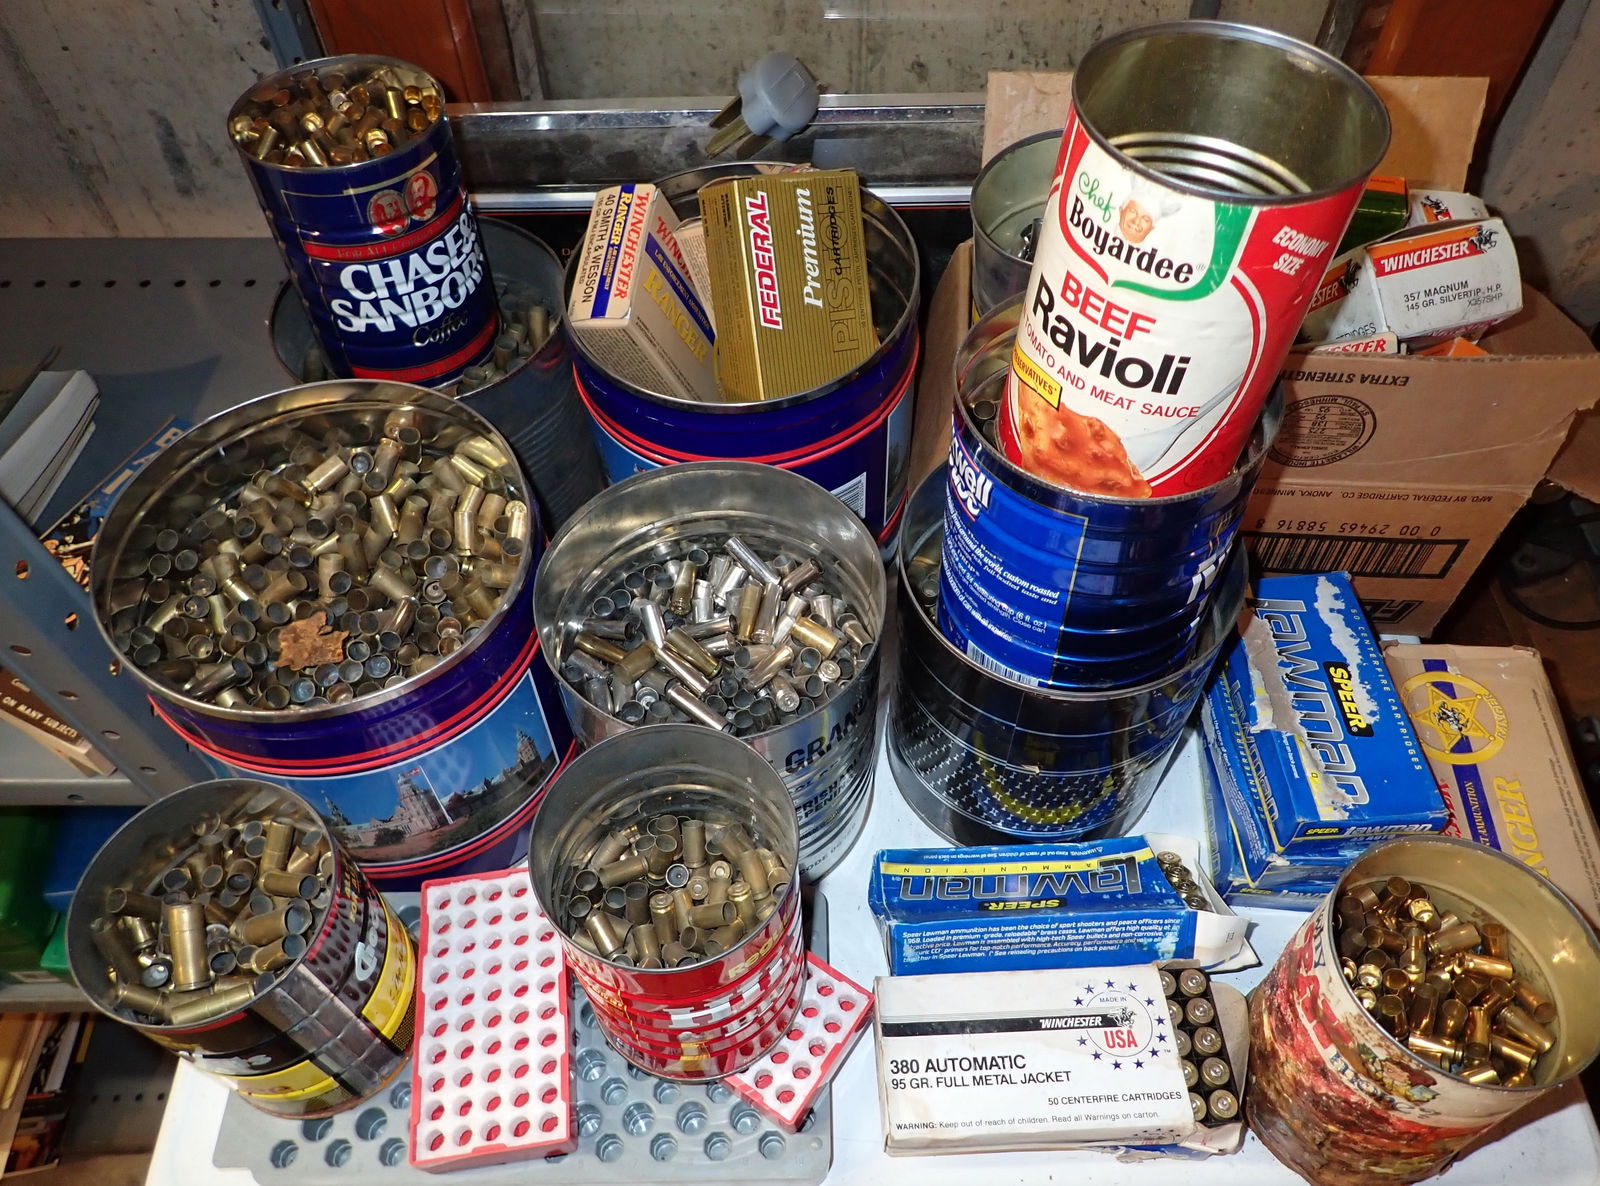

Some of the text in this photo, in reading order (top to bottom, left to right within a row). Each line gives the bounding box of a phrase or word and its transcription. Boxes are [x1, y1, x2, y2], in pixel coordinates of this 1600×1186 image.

[1078, 172, 1117, 224] Chef
[610, 191, 633, 247] RANGER
[825, 185, 843, 276] CARTRIDGES
[582, 193, 617, 304] 40 SMITH & WESSON
[613, 191, 651, 300] WINCHESTER
[796, 187, 824, 309] Premium
[1069, 195, 1194, 285] Boyardee
[1272, 225, 1329, 260] ECONOMY
[340, 224, 467, 301] CHASE
[746, 190, 783, 330] FEDERAL
[1272, 252, 1304, 276] SIZE
[1380, 239, 1471, 273] WINCHESTER
[819, 186, 860, 353] PISTOL
[1403, 280, 1470, 304] 357 MAGNUM
[1406, 283, 1503, 312] 145 GR. SILVERTIP H.P.
[643, 267, 708, 363] RANGER
[1060, 270, 1157, 341] BEEF
[1032, 271, 1192, 396] Ravioli
[1025, 318, 1202, 419] TOMATO AND MEAT SAUCE
[1360, 373, 1411, 387] EXTRA
[1300, 489, 1494, 503] MFD. BY FEDERAL CARTRIDGE CO. ANOKA,
[1255, 518, 1442, 537] 0 00 29465 58816 8
[983, 553, 1004, 576] world,
[1002, 569, 1031, 590] custom
[1029, 583, 1060, 600] roasted
[1020, 584, 1041, 600] taste
[1040, 595, 1059, 606] and
[1012, 613, 1032, 630] Close
[1031, 624, 1046, 634] can
[1015, 610, 1024, 621] (6
[1033, 618, 1048, 629] oz.)
[1328, 665, 1368, 729] SPEER
[1358, 626, 1392, 692] CENTERFIRE
[1388, 697, 1423, 771] CARTRIDGES
[16, 704, 44, 720] MANY
[1483, 691, 1509, 741] RANGER
[1464, 780, 1486, 840] AMMUNITION
[1304, 826, 1340, 835] SPEER
[903, 862, 1093, 874] AMMUNITION
[957, 852, 981, 860] warnings
[987, 899, 1062, 911] SPEER
[902, 931, 923, 939] Speer
[922, 929, 950, 937] Lawman
[949, 927, 988, 935] ammunition
[1059, 921, 1076, 930] sport
[1077, 920, 1105, 928] shooters
[1118, 919, 1138, 927] peace
[922, 935, 946, 943] Loaded
[952, 933, 981, 942] premium
[1078, 926, 1105, 934] Lawman
[1105, 925, 1125, 933] offers
[1140, 924, 1163, 932] quality
[953, 932, 1108, 947] Lawman assembled high-tech Speer bullets
[938, 946, 1075, 961] Speer reloading precautions
[1010, 937, 1123, 950] performance. performance
[1099, 995, 1127, 1004] MADE IN
[1039, 1015, 1102, 1030] WINCHESTER
[1102, 1028, 1138, 1050] USA
[889, 1053, 1027, 1075] 380 AUTOMATIC
[891, 1070, 1072, 1090] 95 GR. FULL METAL JACKET
[1047, 1090, 1183, 1106] 50 CENTERFIRE CARTRIDGES
[895, 1110, 1160, 1131] WARNING: Keep out of reach of children. Read all Warnings on carton.
